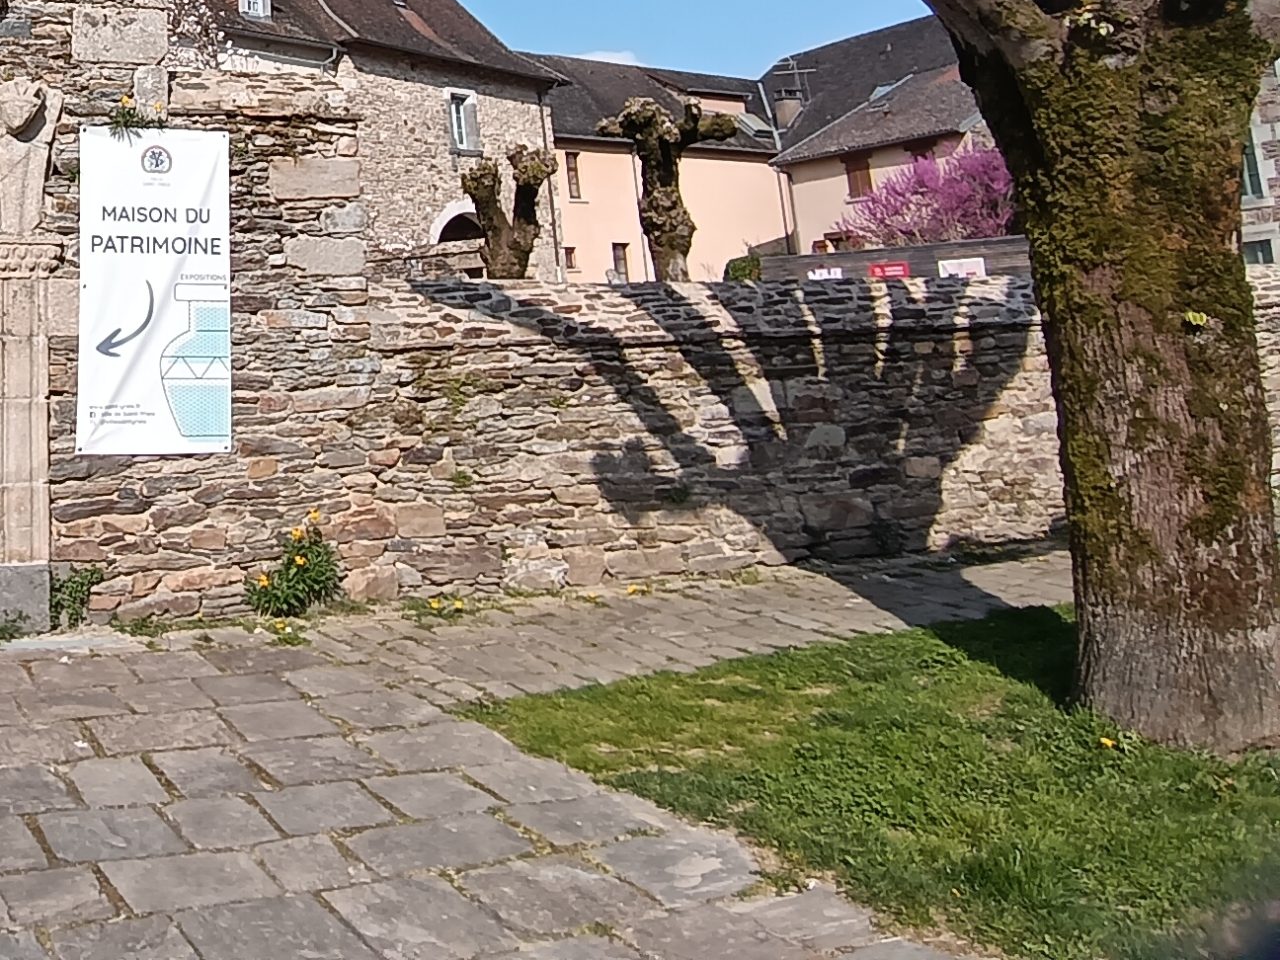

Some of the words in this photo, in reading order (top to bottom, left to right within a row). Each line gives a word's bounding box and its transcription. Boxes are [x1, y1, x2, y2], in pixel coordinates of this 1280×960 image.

[102, 206, 177, 223] MAISON
[186, 208, 210, 224] DU
[91, 235, 222, 256] PATRIMOINE
[180, 273, 227, 281] EXPOSITIONS
